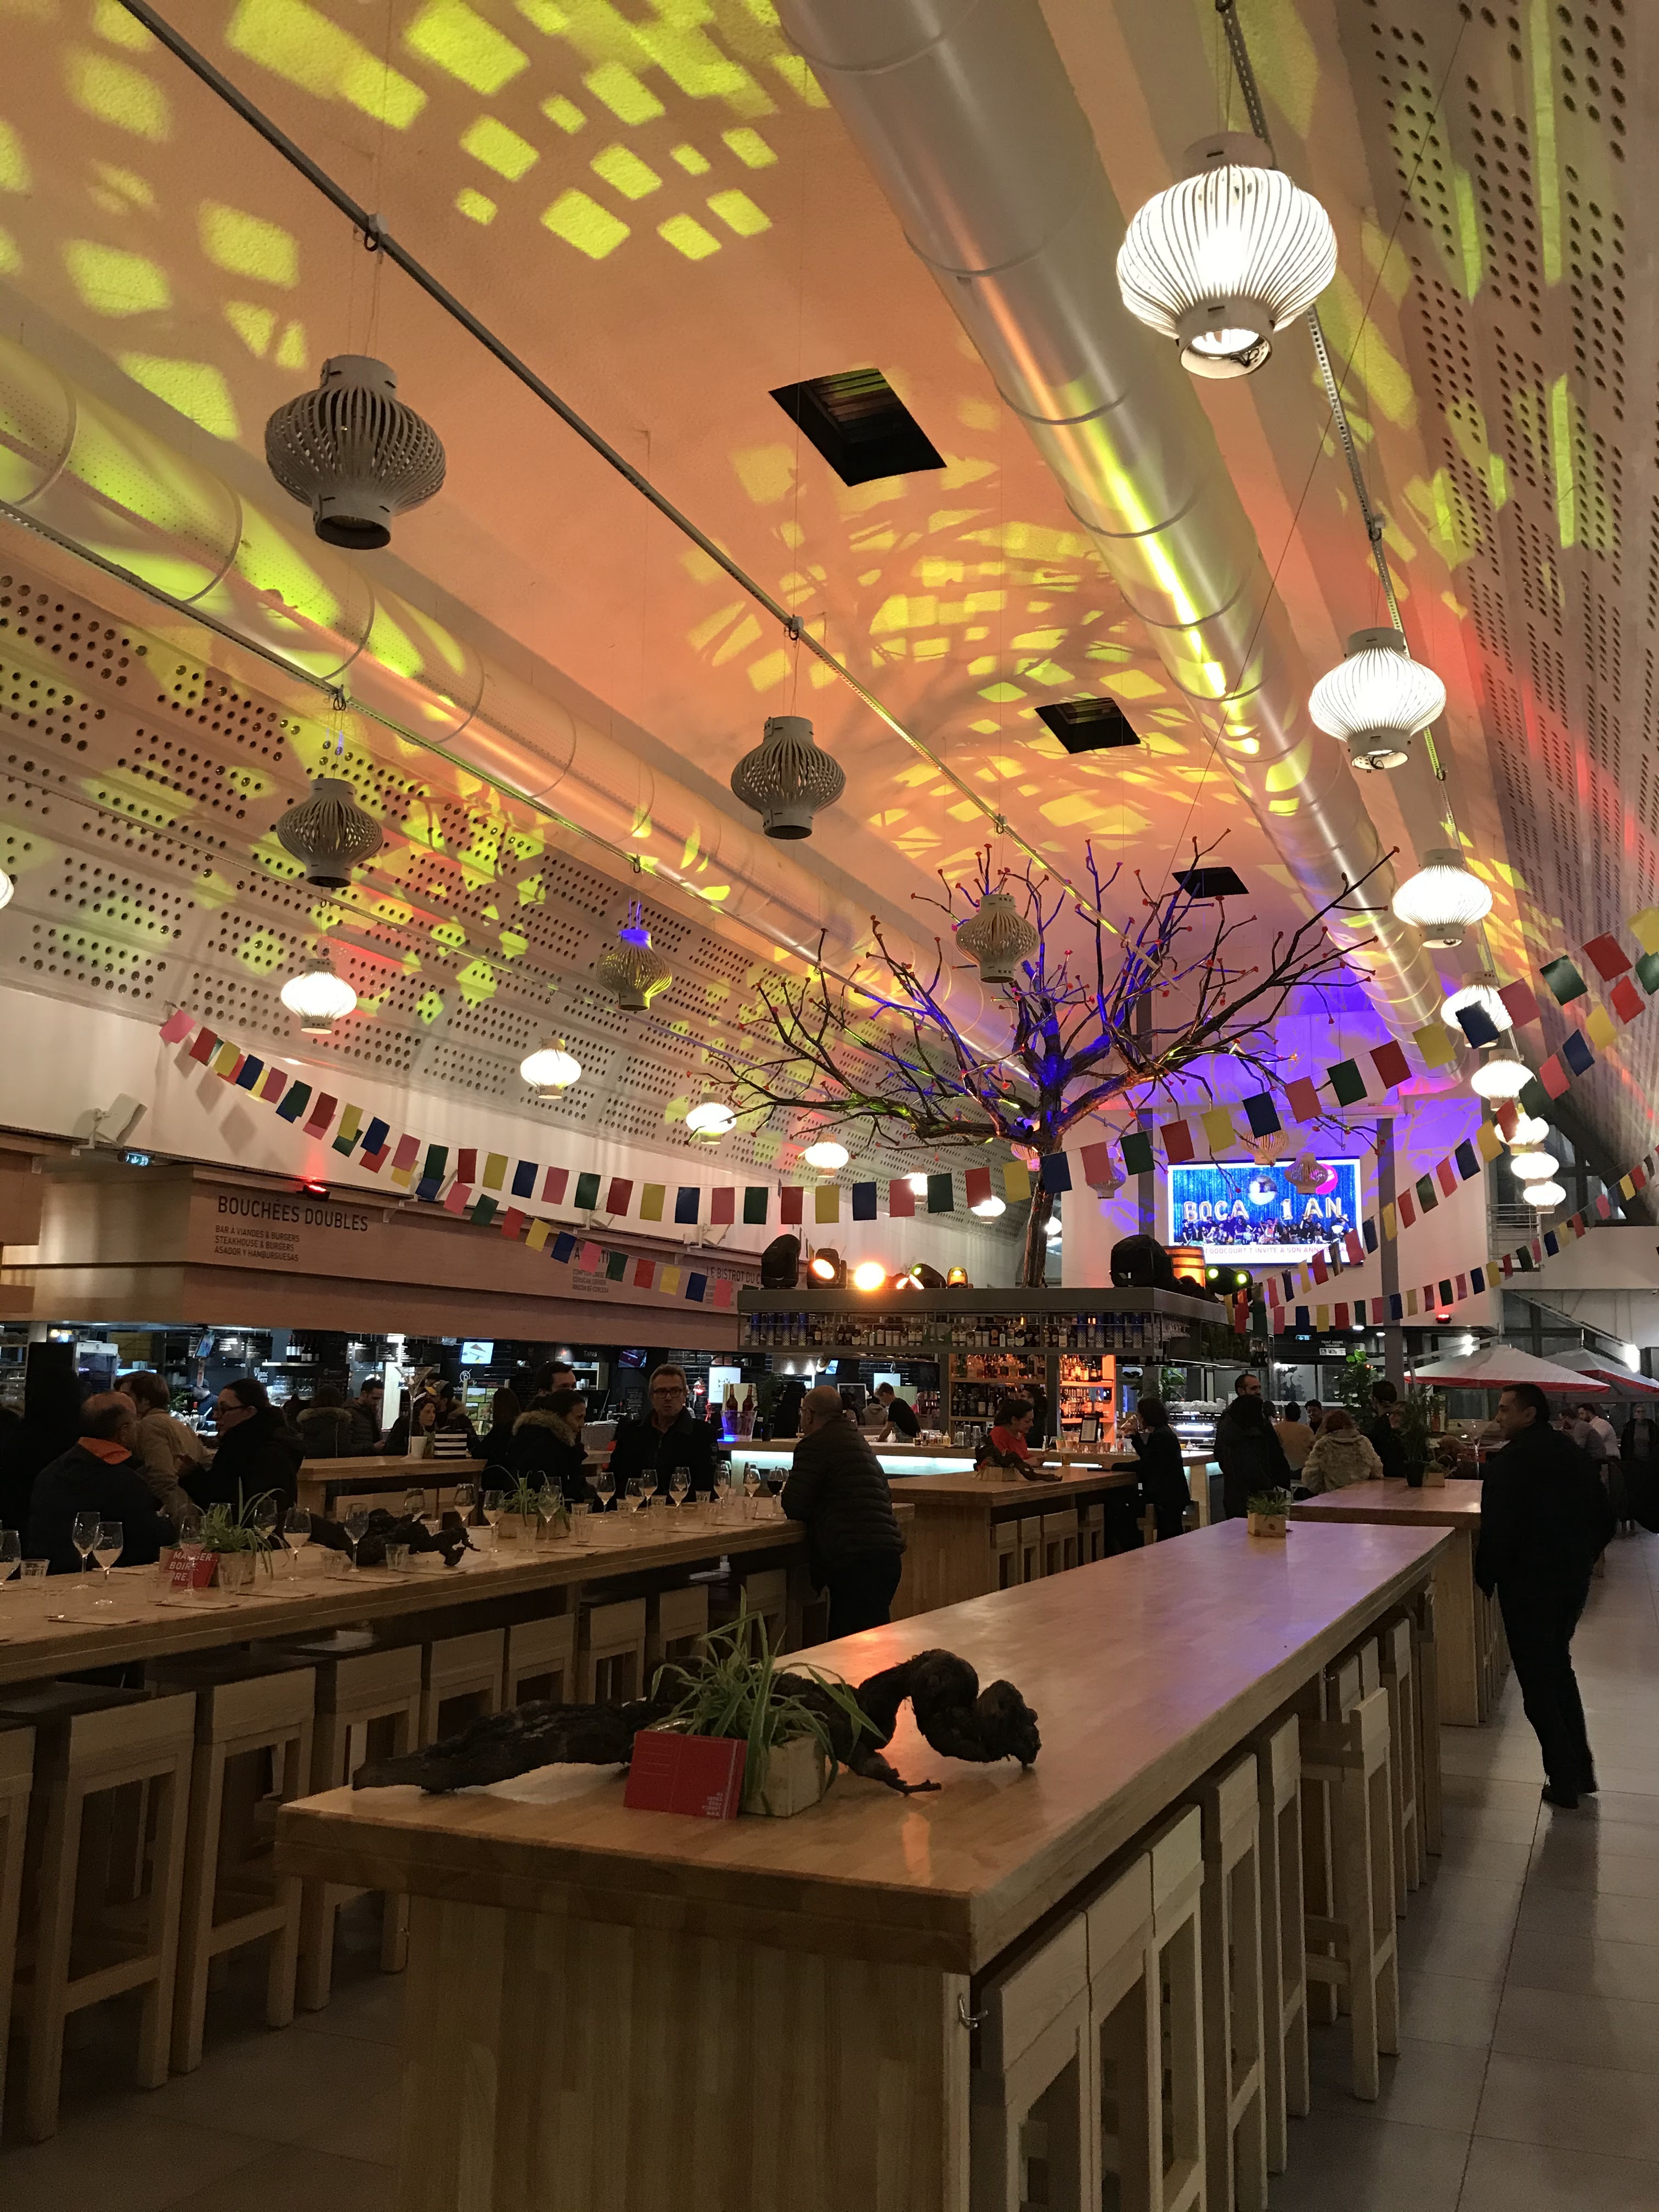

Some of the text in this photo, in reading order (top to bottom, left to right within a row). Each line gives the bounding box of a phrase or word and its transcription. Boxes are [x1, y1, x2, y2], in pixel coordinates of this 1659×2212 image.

[218, 1195, 368, 1232] BOUCHÉES DOUBLES
[1183, 1197, 1342, 1221] BOCA 1 AN
[216, 1224, 229, 1233] BAR
[236, 1227, 264, 1238] VIANDES
[266, 1231, 270, 1239] &
[271, 1232, 300, 1242] BURGERS
[215, 1235, 259, 1248] STEAKHOUSE
[266, 1241, 295, 1251] BURGERS
[214, 1246, 241, 1255] ASADOR
[248, 1249, 299, 1261] HAMBURGUESAS
[717, 1268, 744, 1282] BISTROT
[747, 1272, 755, 1283] DU
